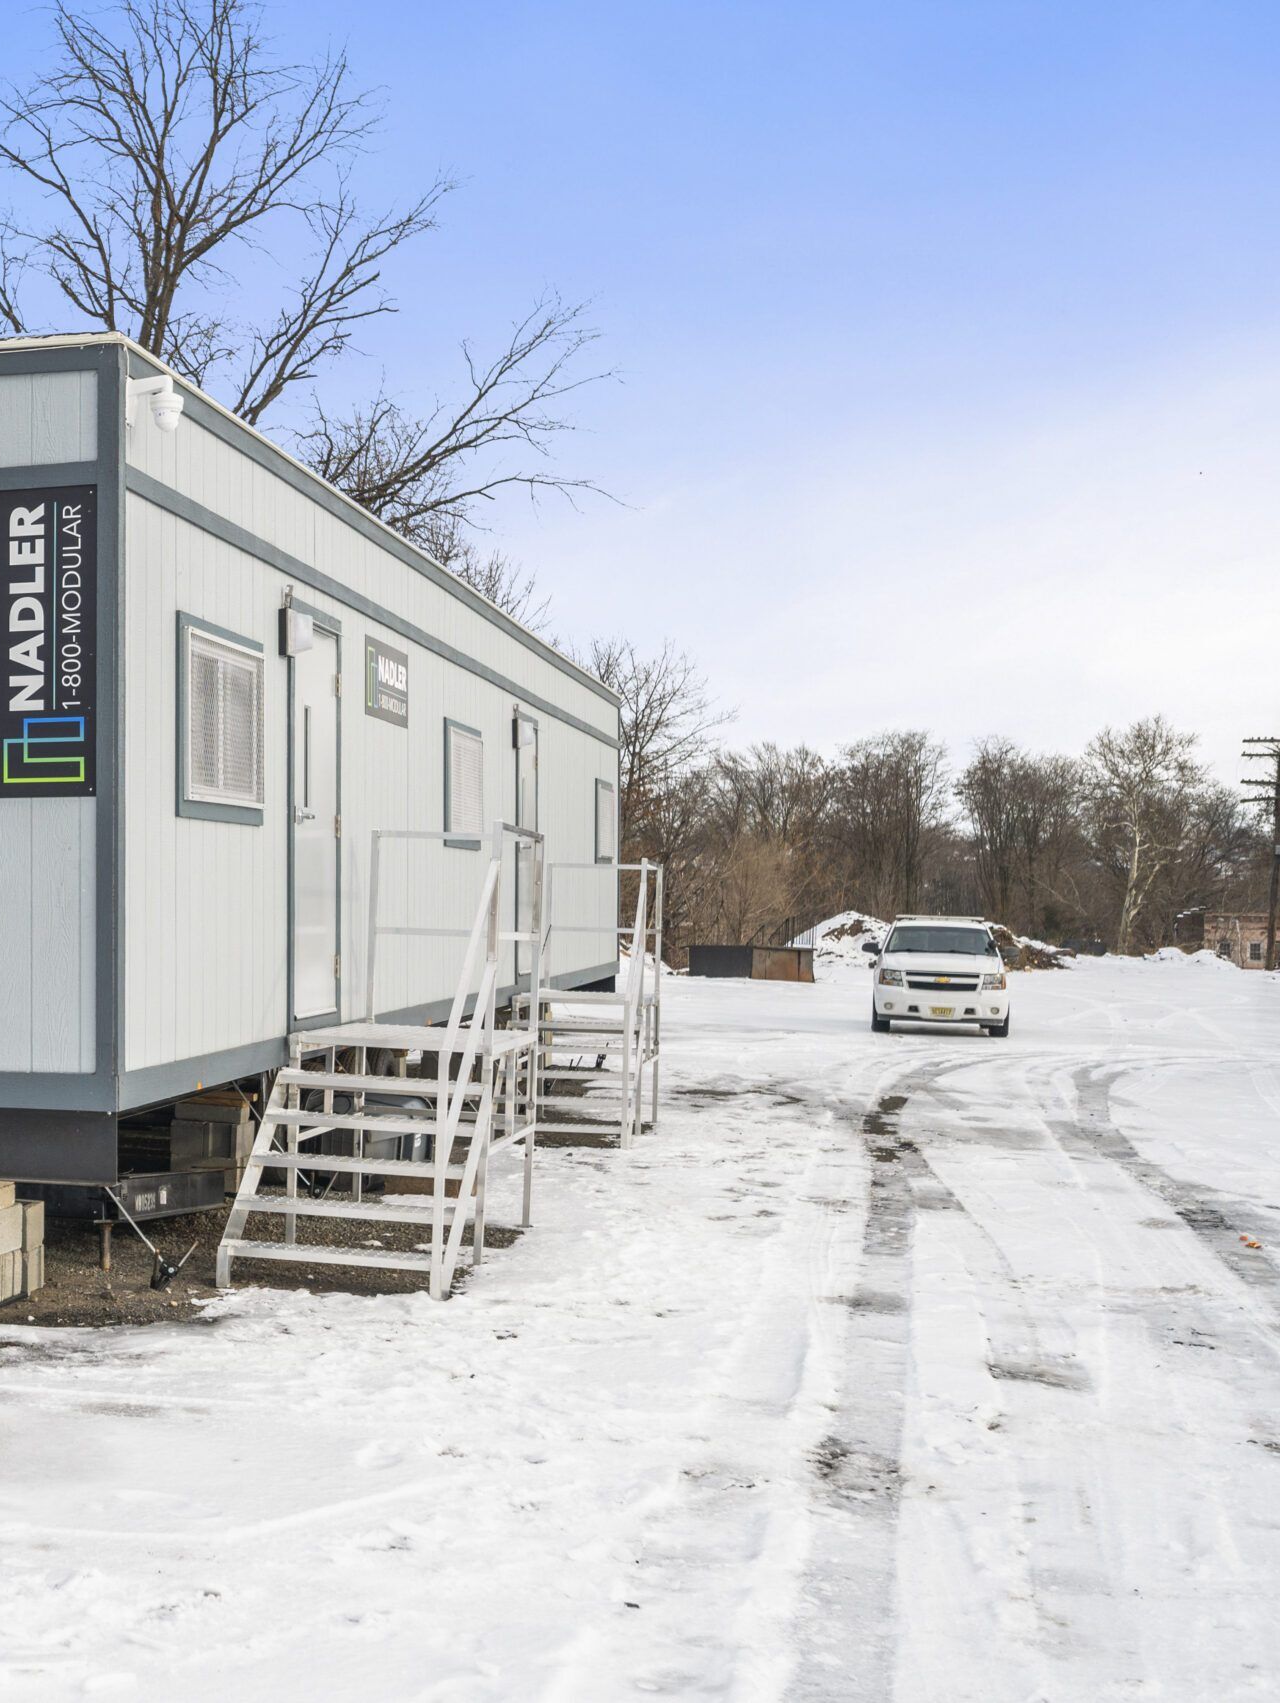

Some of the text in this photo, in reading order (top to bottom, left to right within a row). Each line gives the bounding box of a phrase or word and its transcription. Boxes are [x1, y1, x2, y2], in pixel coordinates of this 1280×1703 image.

[9, 502, 45, 712] NADLER
[61, 504, 82, 710] 1-800-MODULAR
[378, 655, 407, 692] NADLER
